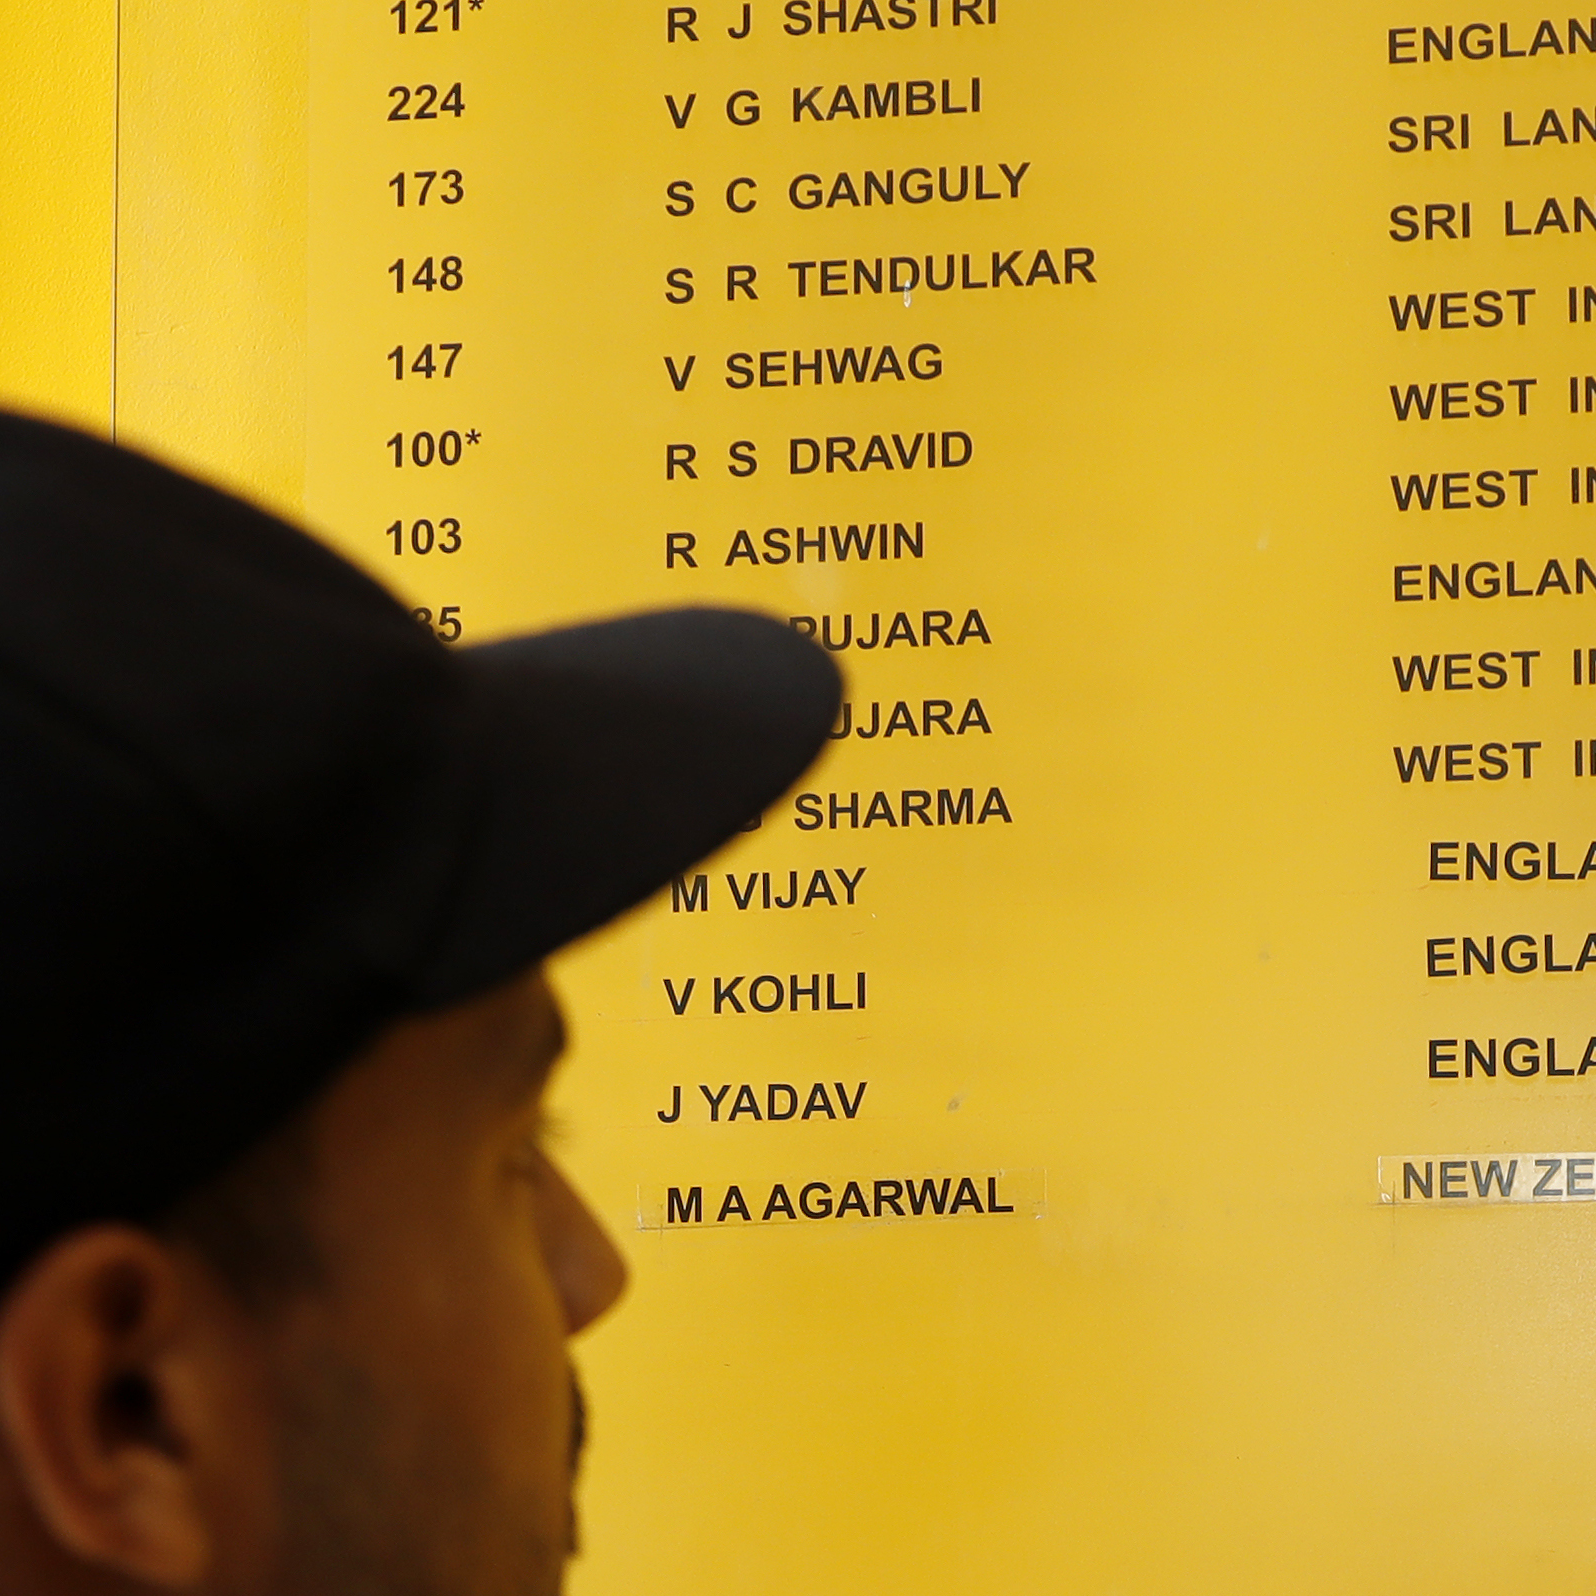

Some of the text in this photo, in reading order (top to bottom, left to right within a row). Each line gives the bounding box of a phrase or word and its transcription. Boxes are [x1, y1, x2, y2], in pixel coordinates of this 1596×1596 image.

[667, 0, 999, 44] R J SHASTRI
[386, 81, 466, 122] 224
[663, 76, 981, 130] V G KAMBLI
[1388, 113, 1470, 154] SRI
[388, 168, 465, 208] 173
[665, 161, 1031, 218] S C GANGULY
[1388, 201, 1471, 243] SRI
[387, 255, 464, 294] 148
[664, 247, 1098, 305] S R TENDULKAR
[1388, 288, 1537, 332] WEST
[386, 342, 463, 381] 147
[663, 342, 943, 392] V SEHWAG
[1389, 378, 1538, 422] WEST
[666, 430, 973, 481] R S DRAVID
[1389, 468, 1539, 512] WEST
[385, 517, 462, 556] 103
[666, 521, 924, 570] R ASHWIN
[1391, 650, 1541, 693] WEST
[1392, 740, 1542, 784] WEST
[794, 786, 1013, 831] SHARMA
[672, 866, 867, 913] M VIJAY
[662, 971, 866, 1016] V KOHLI
[656, 1081, 868, 1124] J YADAV
[667, 1176, 1015, 1224] M A AGARWAL
[1402, 1159, 1519, 1200] NEW
